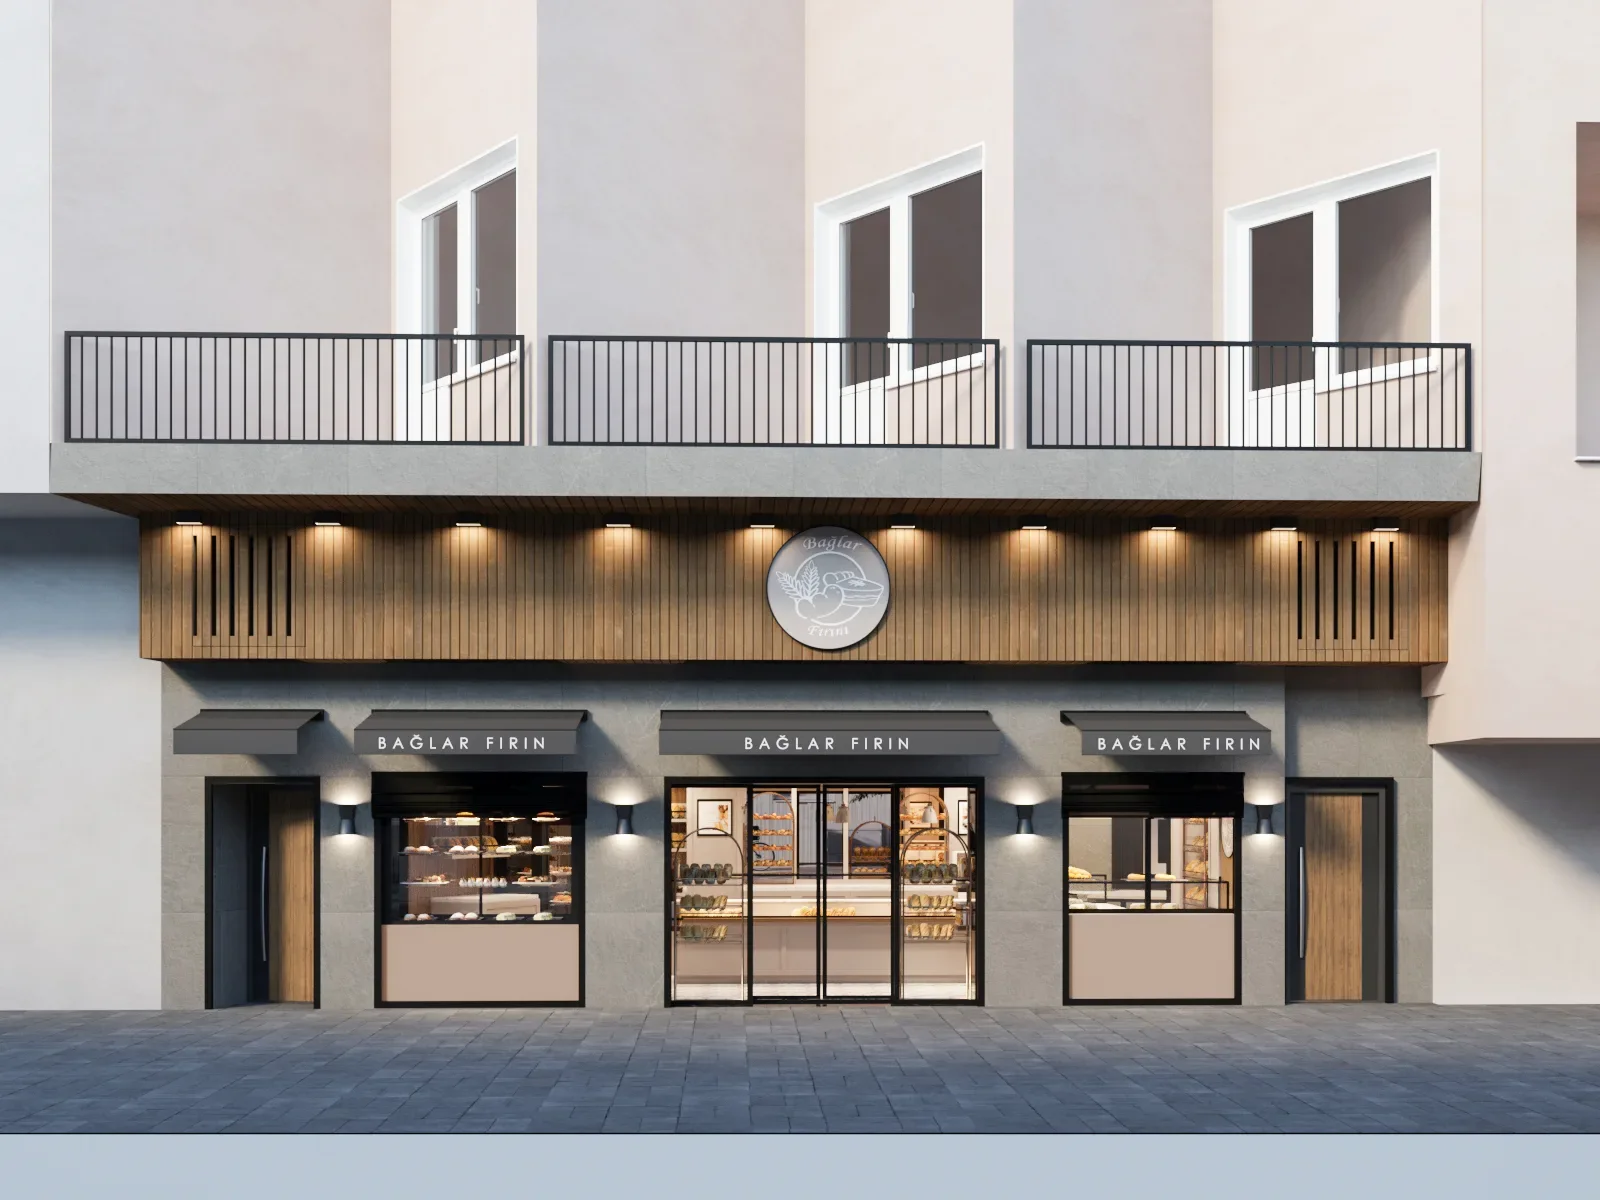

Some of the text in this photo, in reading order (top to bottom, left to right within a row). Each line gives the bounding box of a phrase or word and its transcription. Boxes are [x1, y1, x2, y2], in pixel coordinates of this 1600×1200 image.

[803, 535, 863, 551] Bağlar
[378, 734, 545, 750] BAĞLAR FIRIN
[744, 734, 909, 750] BAĞLAR FIRIN
[1097, 735, 1260, 751] BAĞLAR FIRIN
